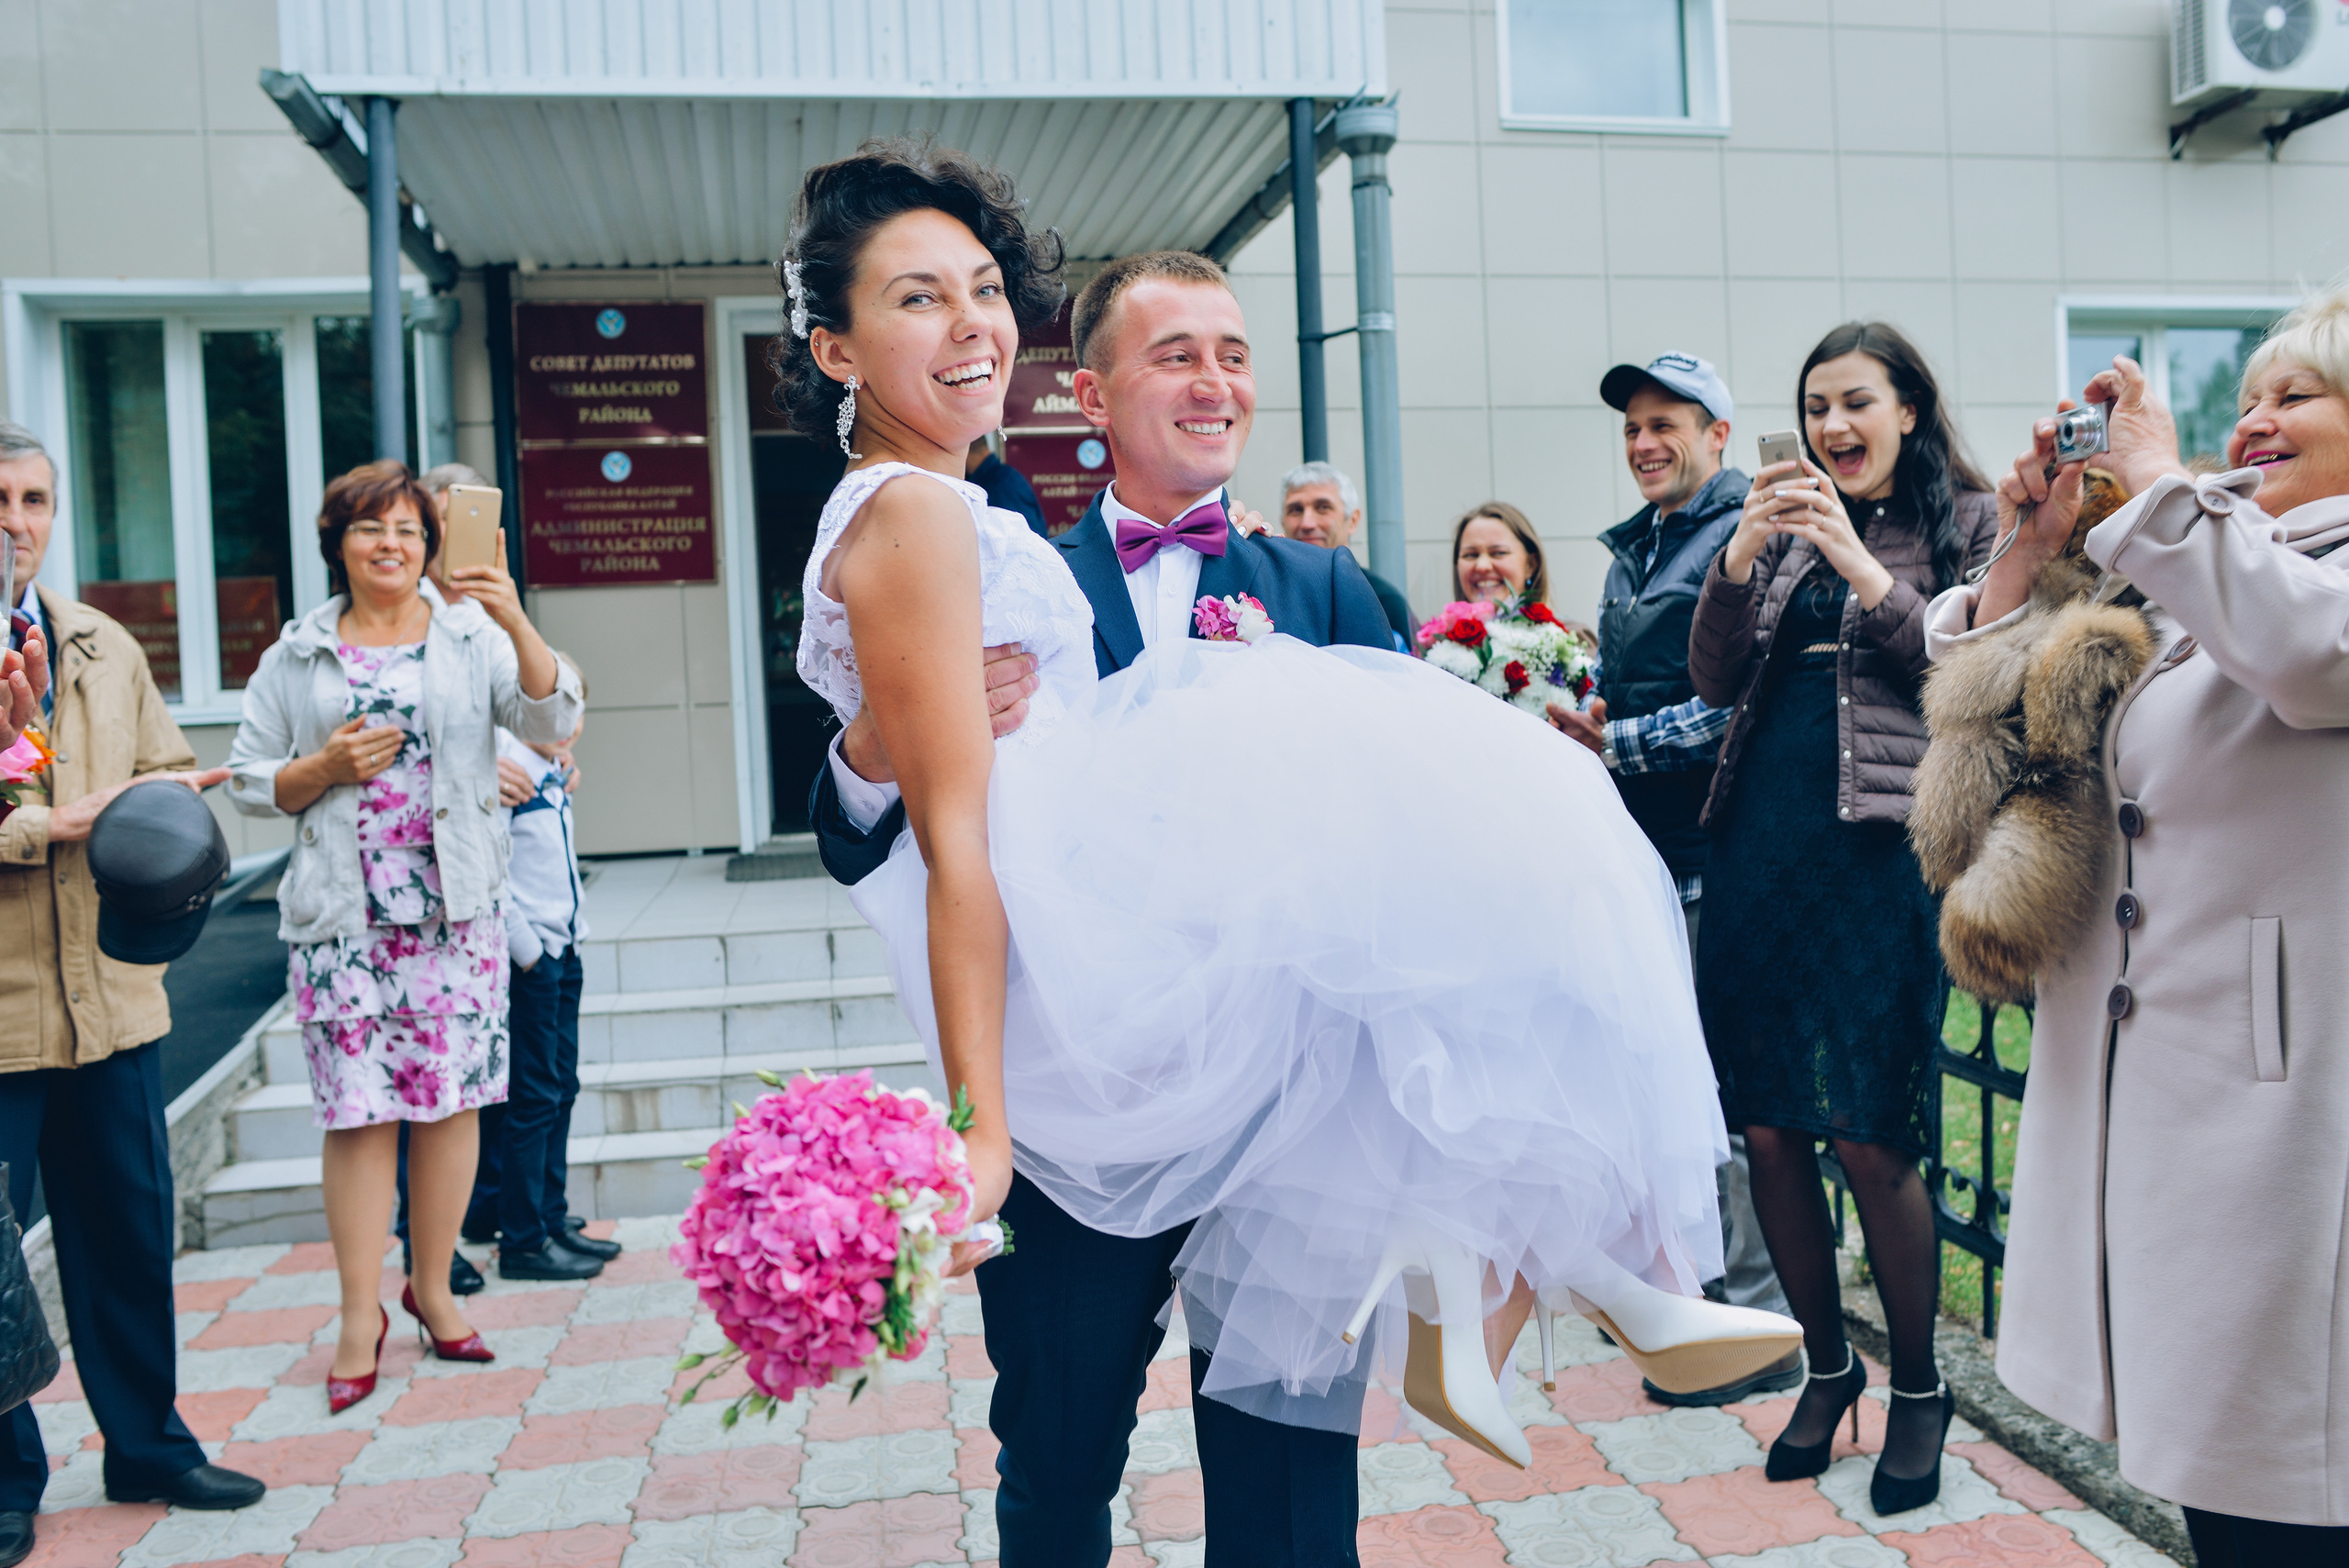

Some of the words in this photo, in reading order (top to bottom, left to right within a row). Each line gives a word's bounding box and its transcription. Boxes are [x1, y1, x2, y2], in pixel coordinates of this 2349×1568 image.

[2336, 9, 2349, 26] L
[529, 355, 589, 373] СОВЕТ
[591, 353, 696, 373] ДЕПУТАТОВ
[1032, 393, 1081, 413] АЙМ
[579, 403, 653, 424] РАЙОНА
[530, 517, 707, 537] АДМИНИСТРАЦИЯ
[549, 536, 692, 555] ЧЕМАЛЬСКОГО
[581, 554, 661, 573] РАЙОНА
